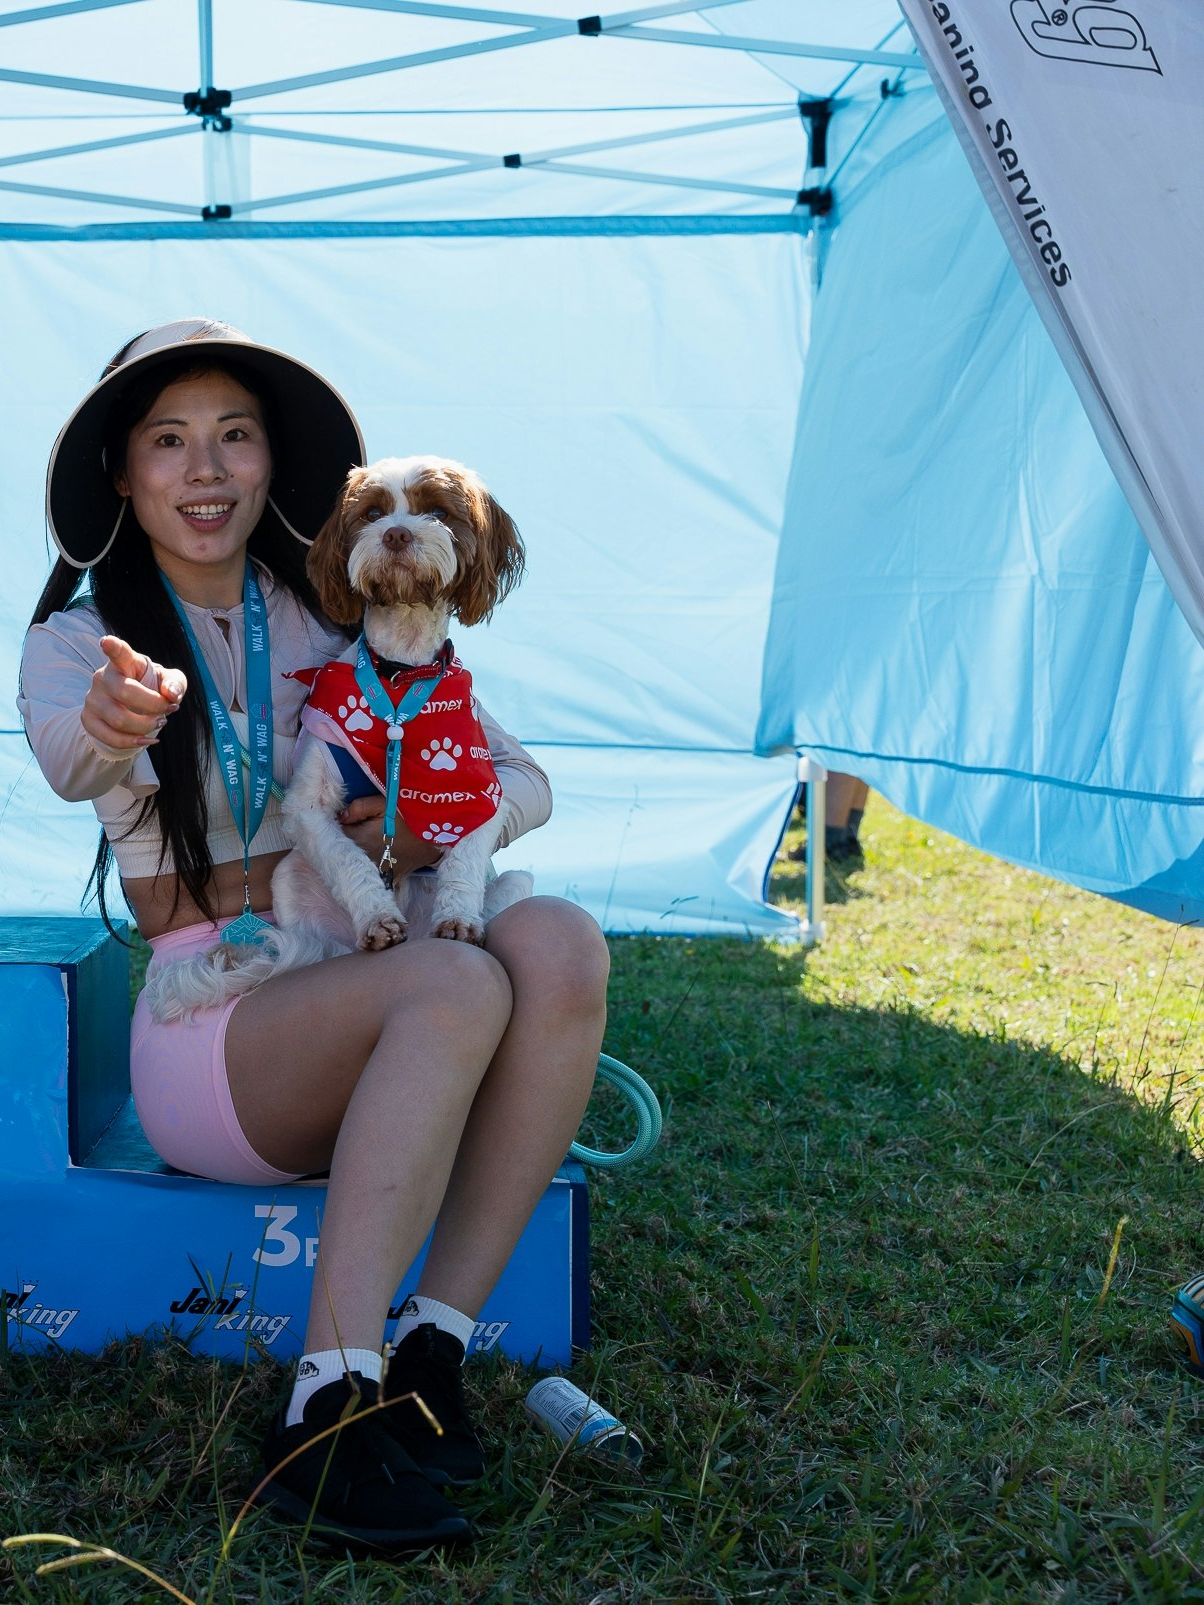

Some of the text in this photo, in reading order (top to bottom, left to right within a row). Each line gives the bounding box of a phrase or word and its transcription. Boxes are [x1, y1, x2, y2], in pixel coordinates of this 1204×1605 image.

[926, 0, 1072, 288] aning Services
[248, 579, 260, 599] WAG
[251, 624, 264, 652] WALK
[420, 699, 463, 715] amex
[209, 700, 229, 731] WALK
[225, 758, 239, 785] WAG
[256, 723, 268, 747] WAG
[254, 776, 267, 809] WALK
